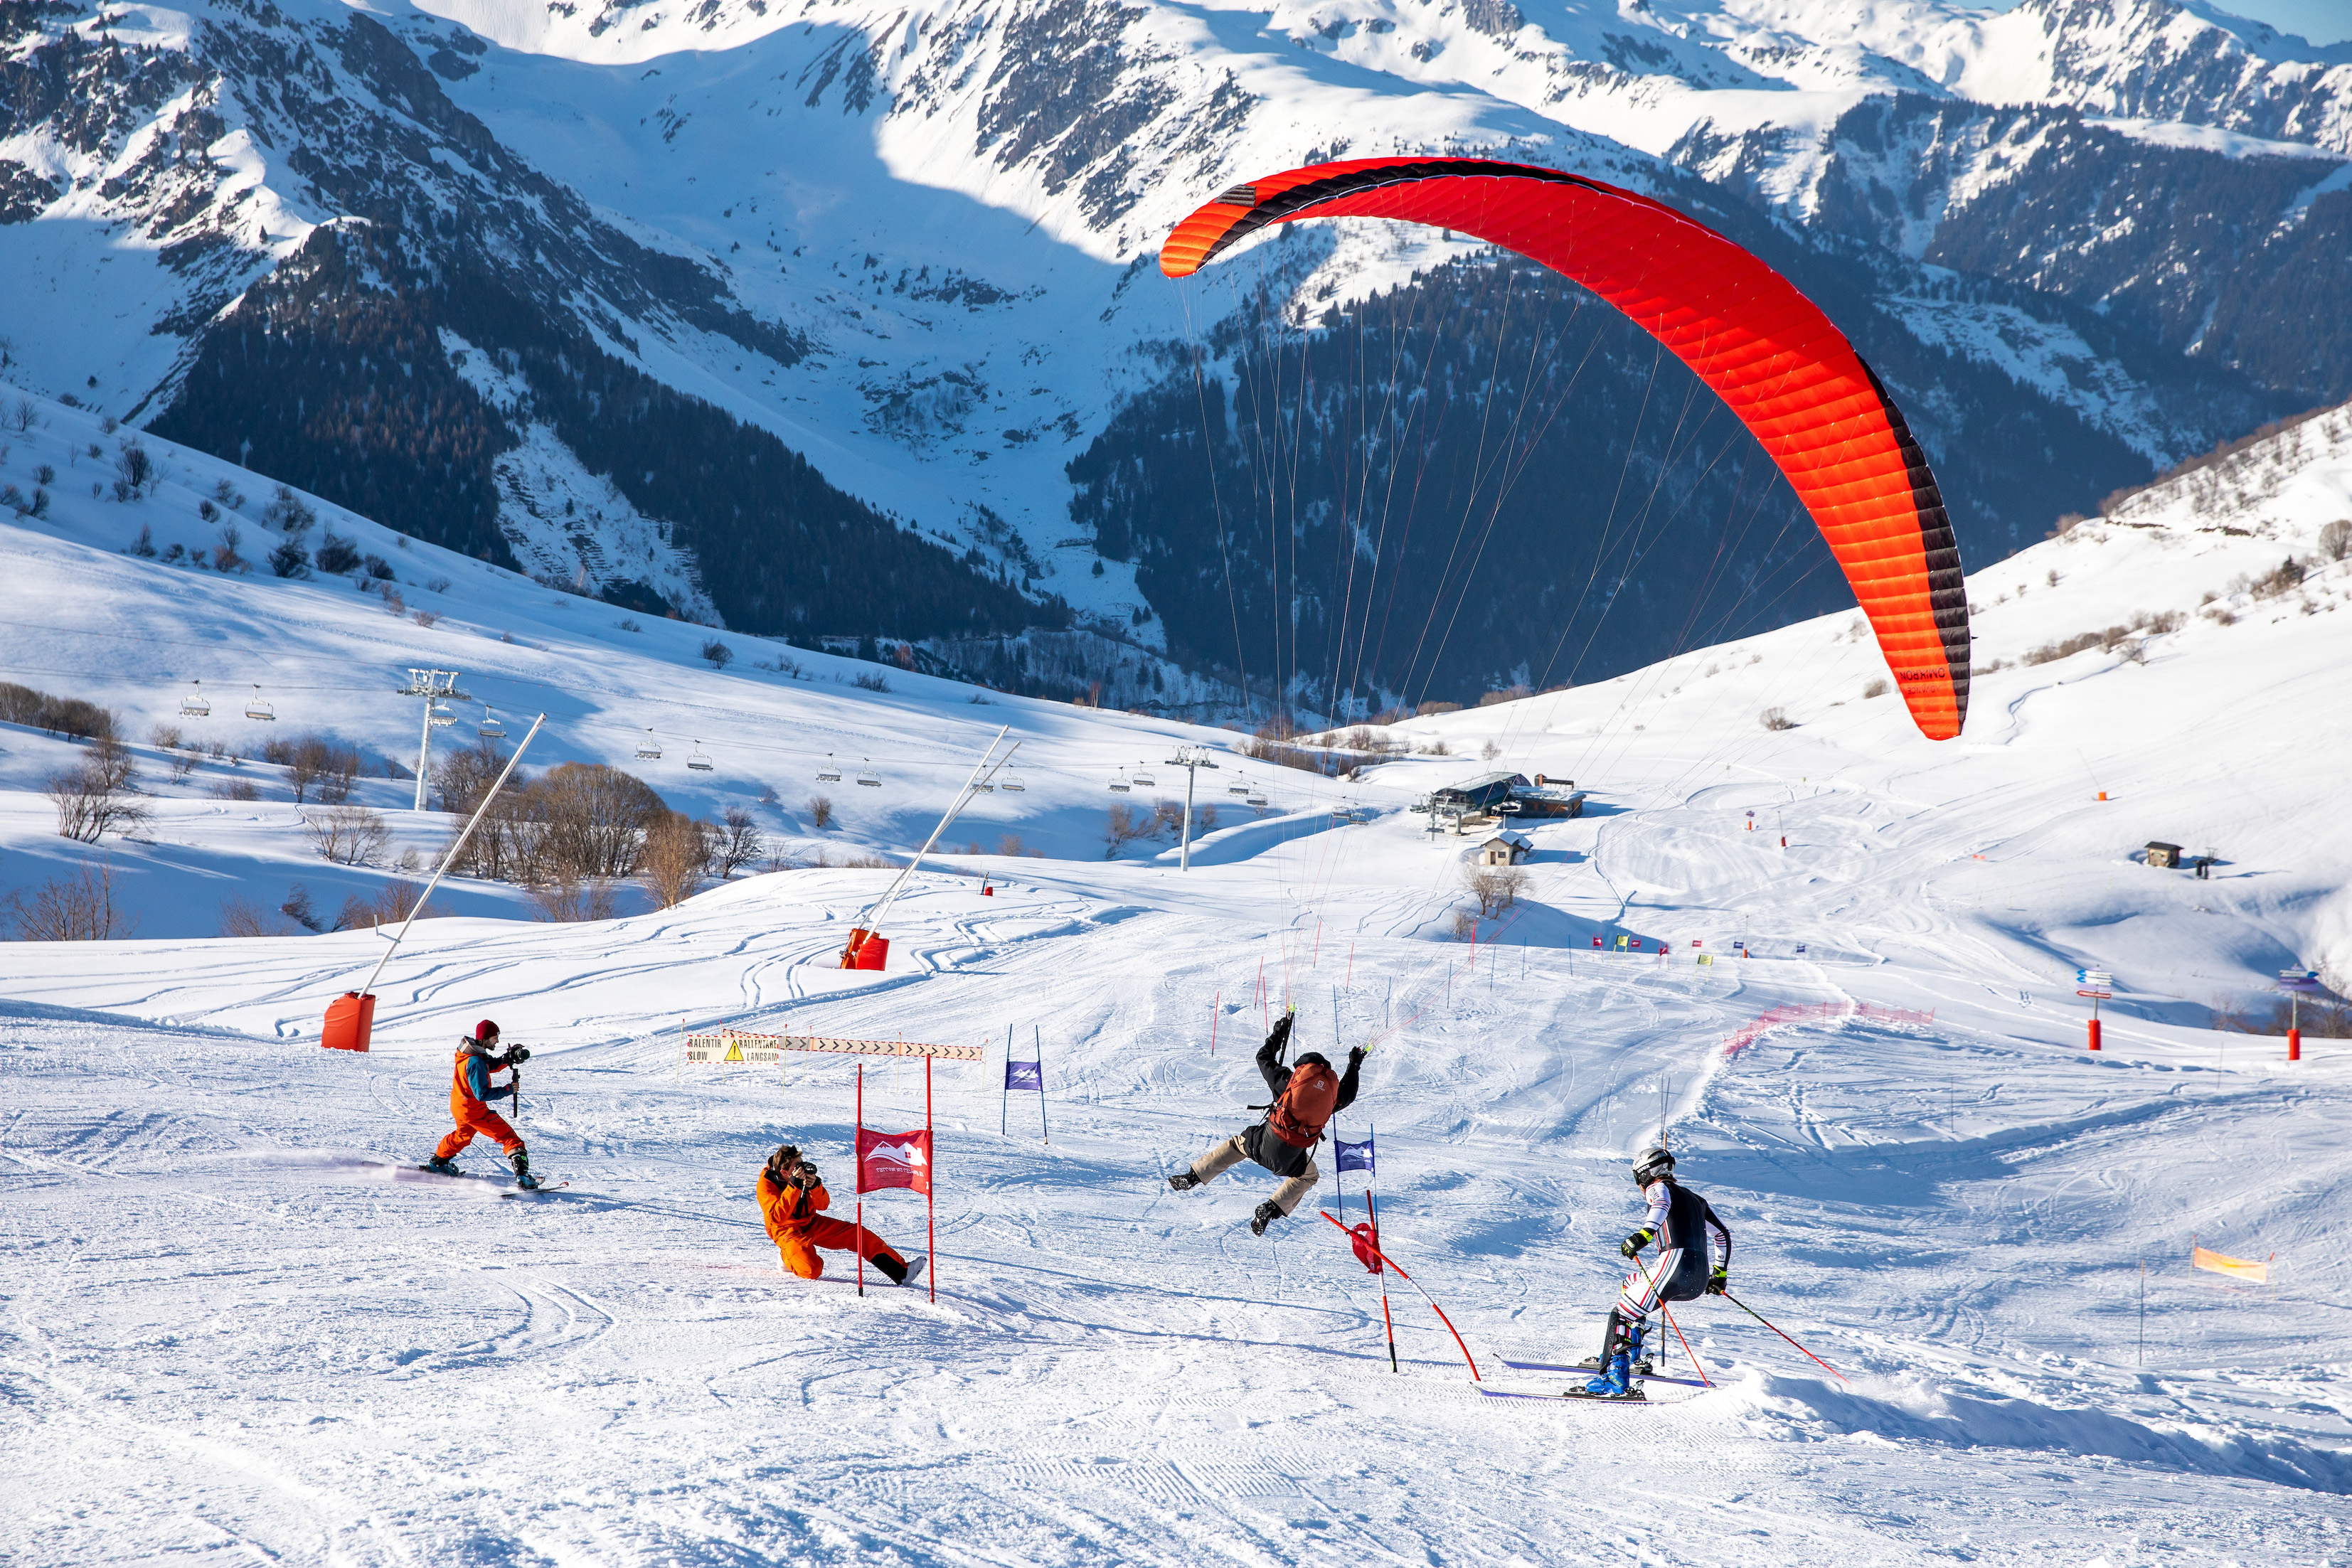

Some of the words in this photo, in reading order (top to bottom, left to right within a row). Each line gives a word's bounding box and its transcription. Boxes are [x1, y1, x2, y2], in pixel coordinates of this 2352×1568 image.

[1900, 667, 1945, 681] OMIKRON
[1907, 685, 1941, 695] ADVANCE
[688, 1038, 722, 1048] RALENTIR
[739, 1039, 777, 1049] RALLENTARE
[688, 1051, 708, 1060] SLOW
[747, 1052, 778, 1062] LANGSAM
[1637, 1163, 1651, 1174] uvex
